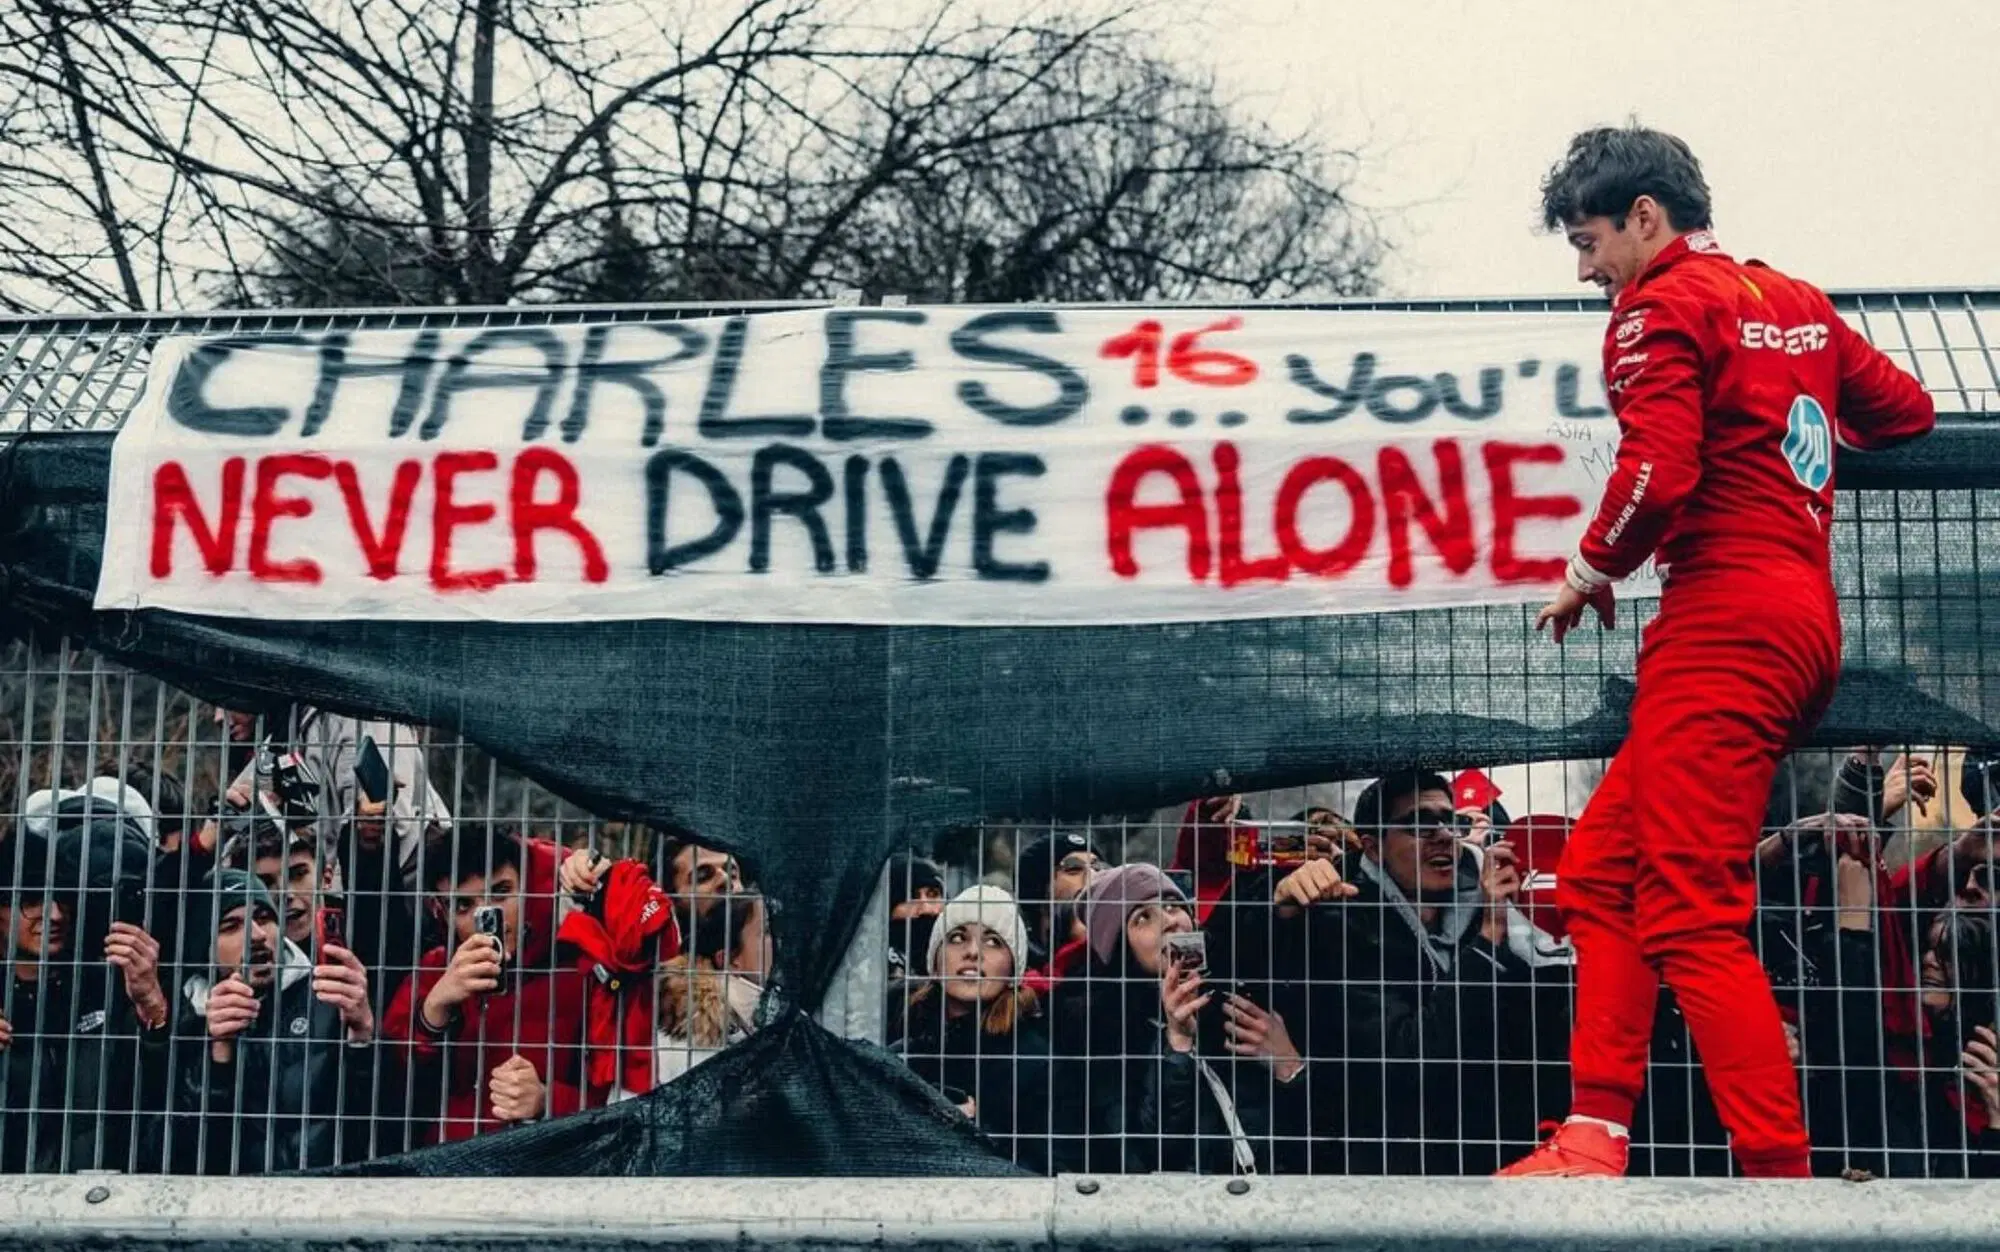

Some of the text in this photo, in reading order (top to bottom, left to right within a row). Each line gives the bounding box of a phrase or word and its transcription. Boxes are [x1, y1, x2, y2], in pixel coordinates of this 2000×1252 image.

[167, 311, 1090, 447] CHARLES
[1100, 317, 1258, 389] 16
[150, 438, 1583, 591] NEVER DRIVE ALONE
[1632, 461, 1653, 504] MILLE
